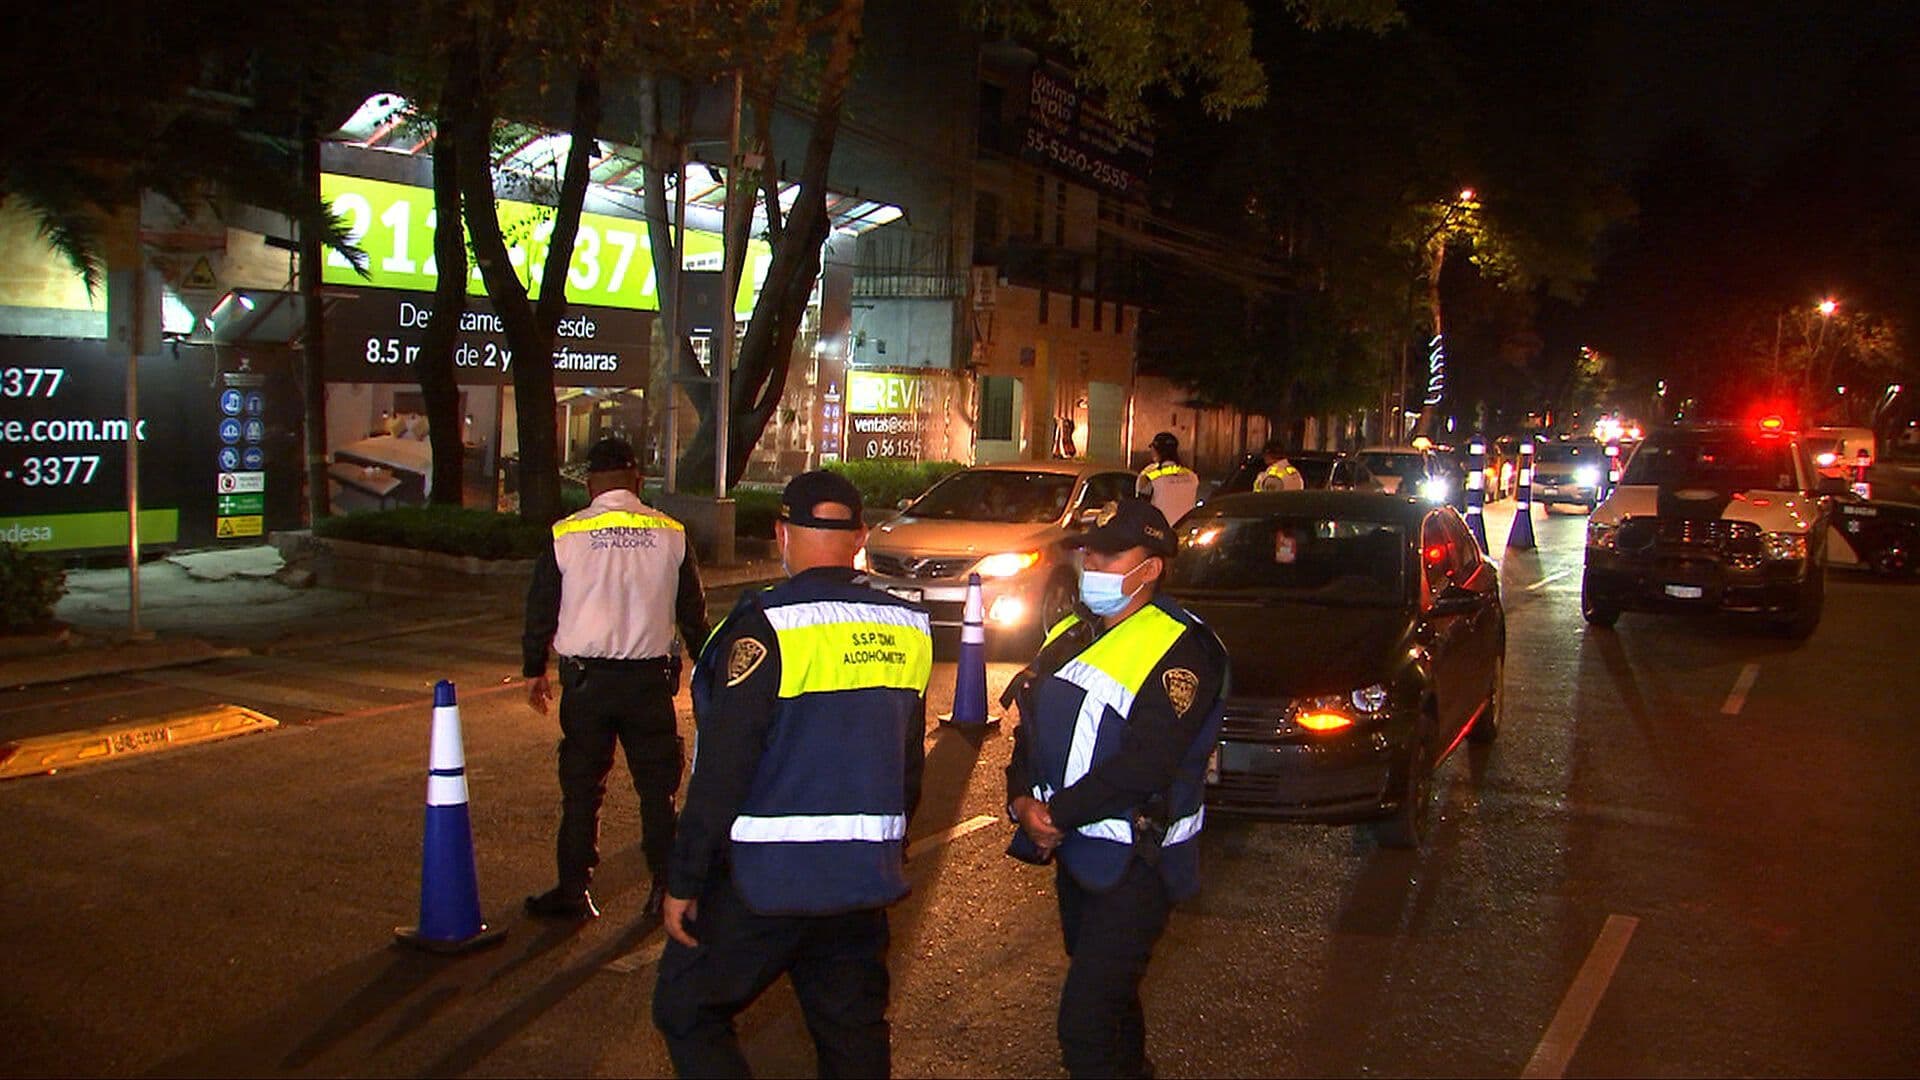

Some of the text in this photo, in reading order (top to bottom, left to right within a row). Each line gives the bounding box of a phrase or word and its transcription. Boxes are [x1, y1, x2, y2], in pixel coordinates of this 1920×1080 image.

[557, 315, 596, 339] esde
[366, 338, 400, 364] 8.5
[455, 342, 479, 367] de
[484, 343, 497, 367] 2
[500, 348, 512, 373] y
[553, 347, 618, 371] cámaras
[0, 368, 64, 397] 377
[22, 456, 100, 486] 3377
